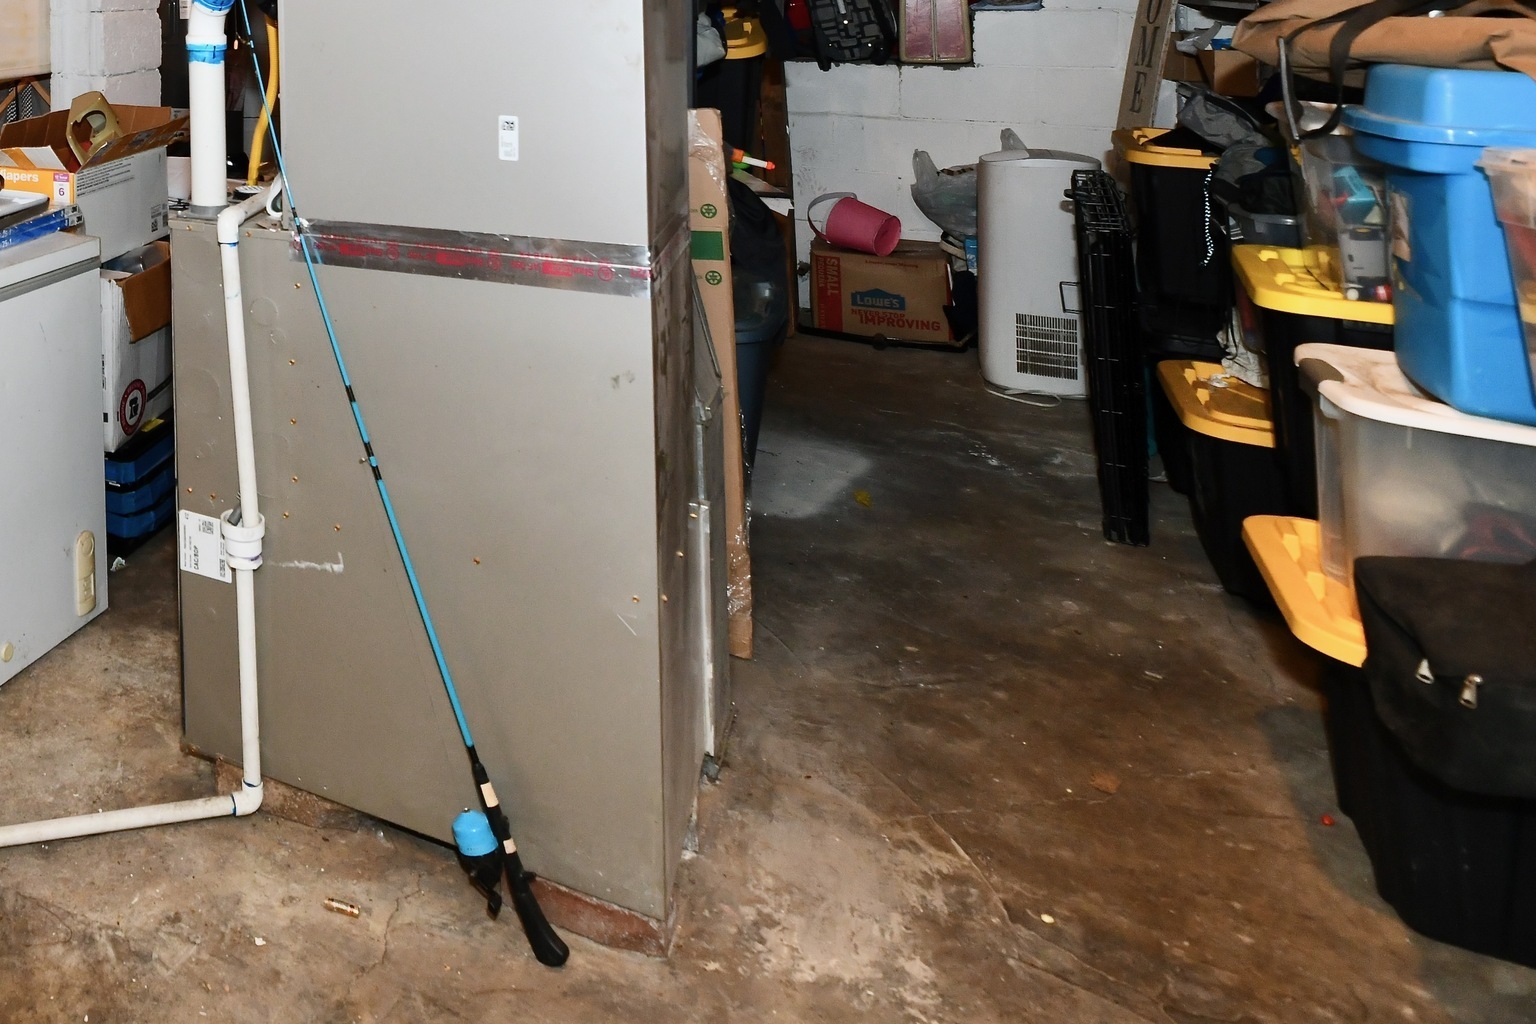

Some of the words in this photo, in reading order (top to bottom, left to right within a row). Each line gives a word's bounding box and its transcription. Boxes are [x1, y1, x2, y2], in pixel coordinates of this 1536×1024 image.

[58, 188, 65, 196] 6
[826, 258, 840, 296] SMALL
[856, 294, 900, 308] LOWE'S
[851, 308, 881, 318] NEVER
[882, 312, 906, 320] STOP
[860, 314, 942, 331] IMPROVING
